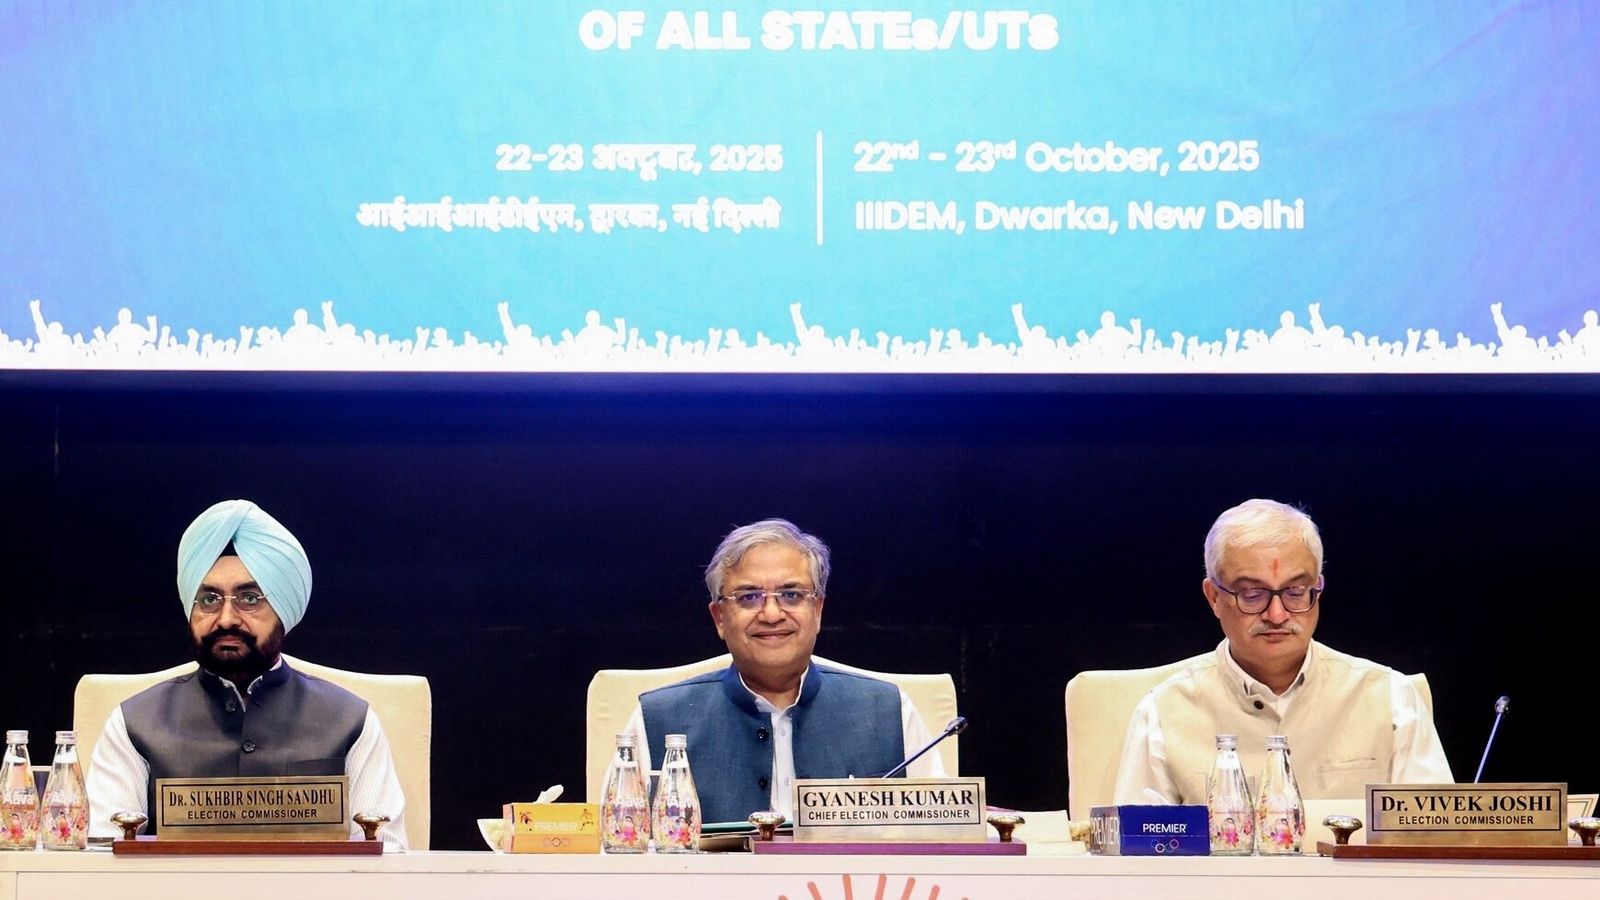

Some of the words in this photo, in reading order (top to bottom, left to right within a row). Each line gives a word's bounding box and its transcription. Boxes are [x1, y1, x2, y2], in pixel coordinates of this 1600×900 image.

[578, 9, 646, 50] OF
[655, 10, 751, 50] ALL
[495, 143, 584, 171] 22-23
[709, 143, 784, 172] 2025
[853, 139, 920, 172] 22nd
[955, 139, 1017, 172] 23rd
[1025, 140, 1170, 177] October,
[1177, 140, 1260, 172] 2025
[672, 196, 710, 233] नई
[712, 196, 782, 234] दिल्ली
[855, 200, 966, 235] IIIDEM,
[975, 199, 1119, 235] Dwarka,
[1127, 200, 1206, 230] New
[1215, 198, 1305, 230] Delhi
[190, 790, 244, 806] SUKHBIR
[246, 789, 285, 806] SINGH
[287, 788, 336, 805] SANDHU
[803, 791, 895, 807] GYANESH
[900, 789, 974, 806] KUMAR
[1381, 796, 1408, 811] Dr.
[1414, 796, 1483, 811] VIVEK
[1488, 795, 1552, 812] JOSHI
[188, 810, 236, 820] ELECTION
[241, 809, 318, 819] COMMISSIONER
[808, 811, 837, 820] CHIEF
[840, 810, 889, 820] ELECTION
[893, 809, 970, 819] COMMISSIONER
[1399, 815, 1449, 825] ELECTION
[1454, 815, 1534, 825] COMMISSIONER
[534, 821, 577, 831] PREMIER
[1142, 823, 1186, 833] PREMIER
